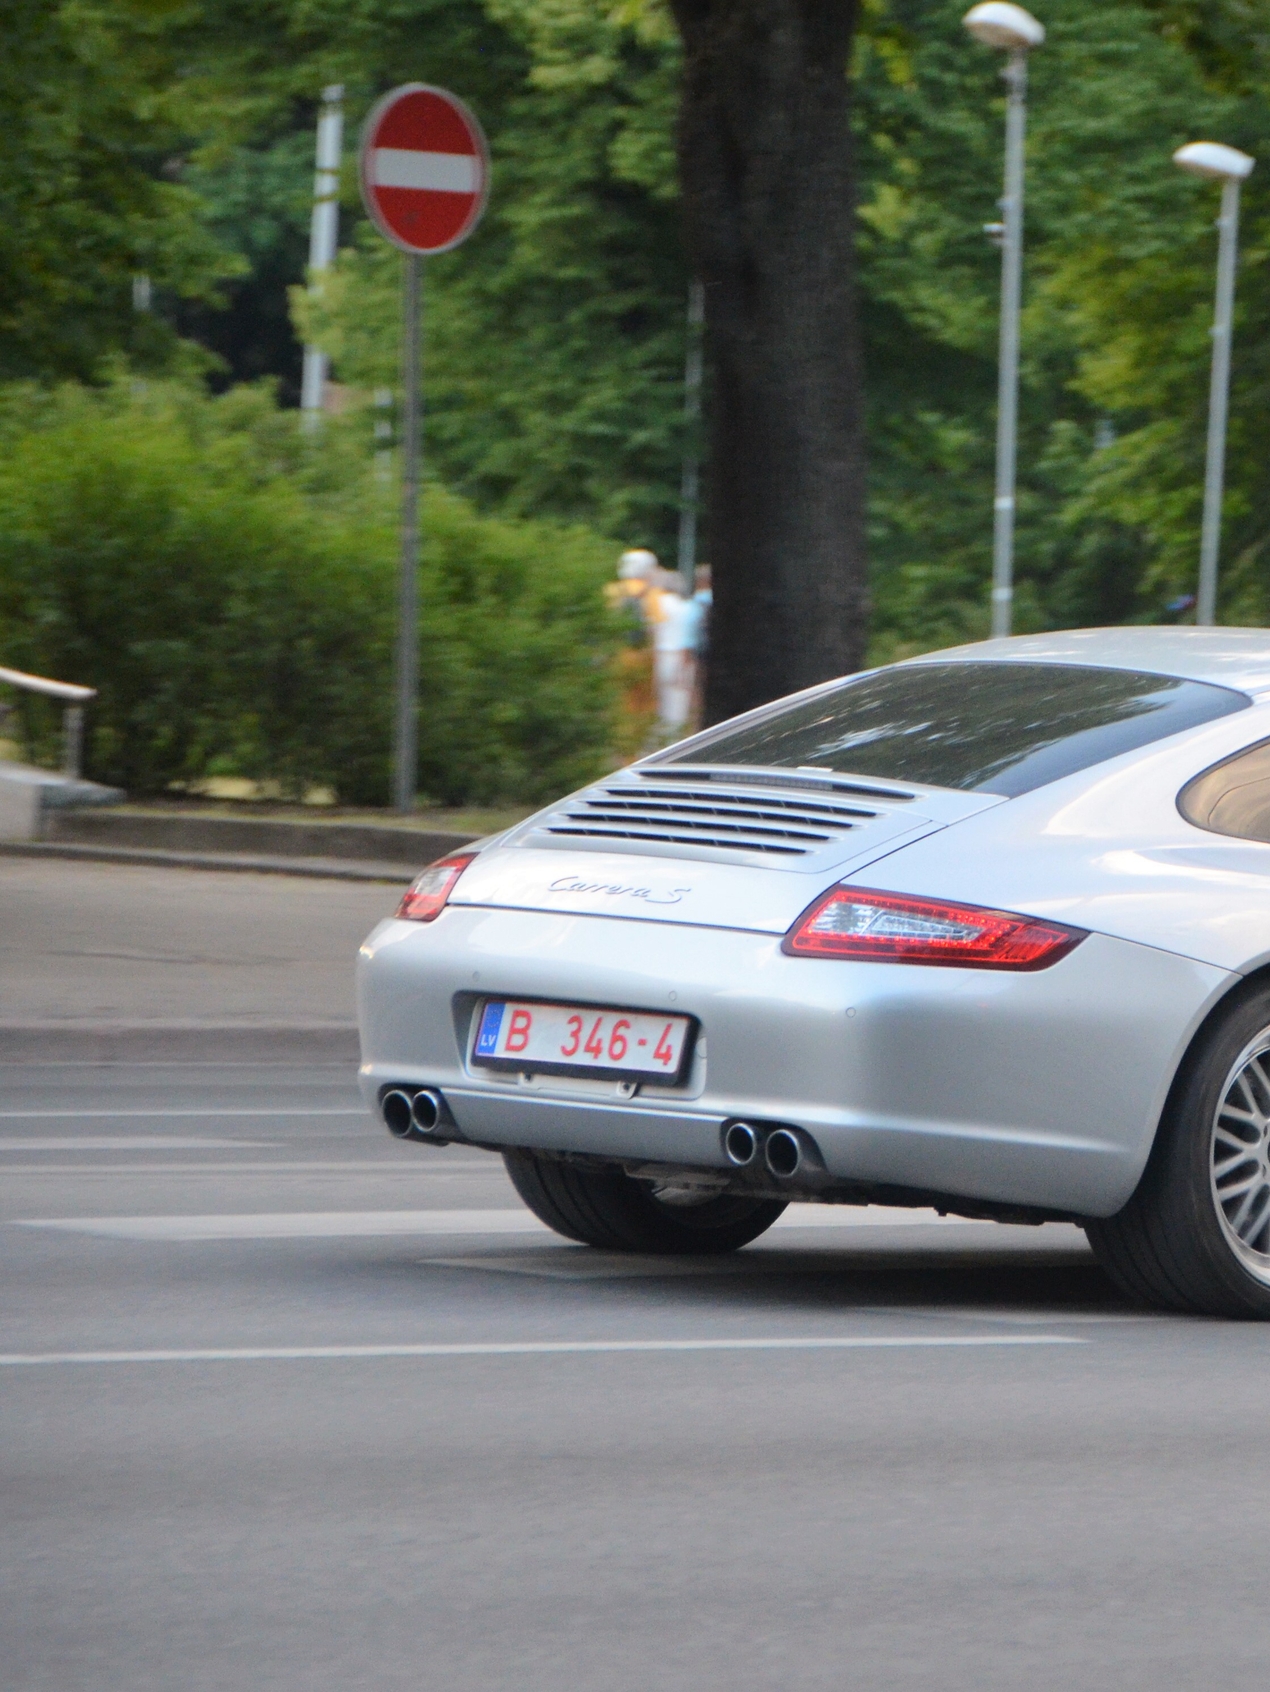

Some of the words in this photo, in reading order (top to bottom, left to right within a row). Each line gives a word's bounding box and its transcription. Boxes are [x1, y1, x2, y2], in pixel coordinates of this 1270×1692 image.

[548, 876, 651, 898] Carrera
[645, 887, 692, 904] S
[481, 1034, 496, 1047] LV
[505, 1009, 533, 1052] B
[561, 1014, 673, 1066] 346-4
